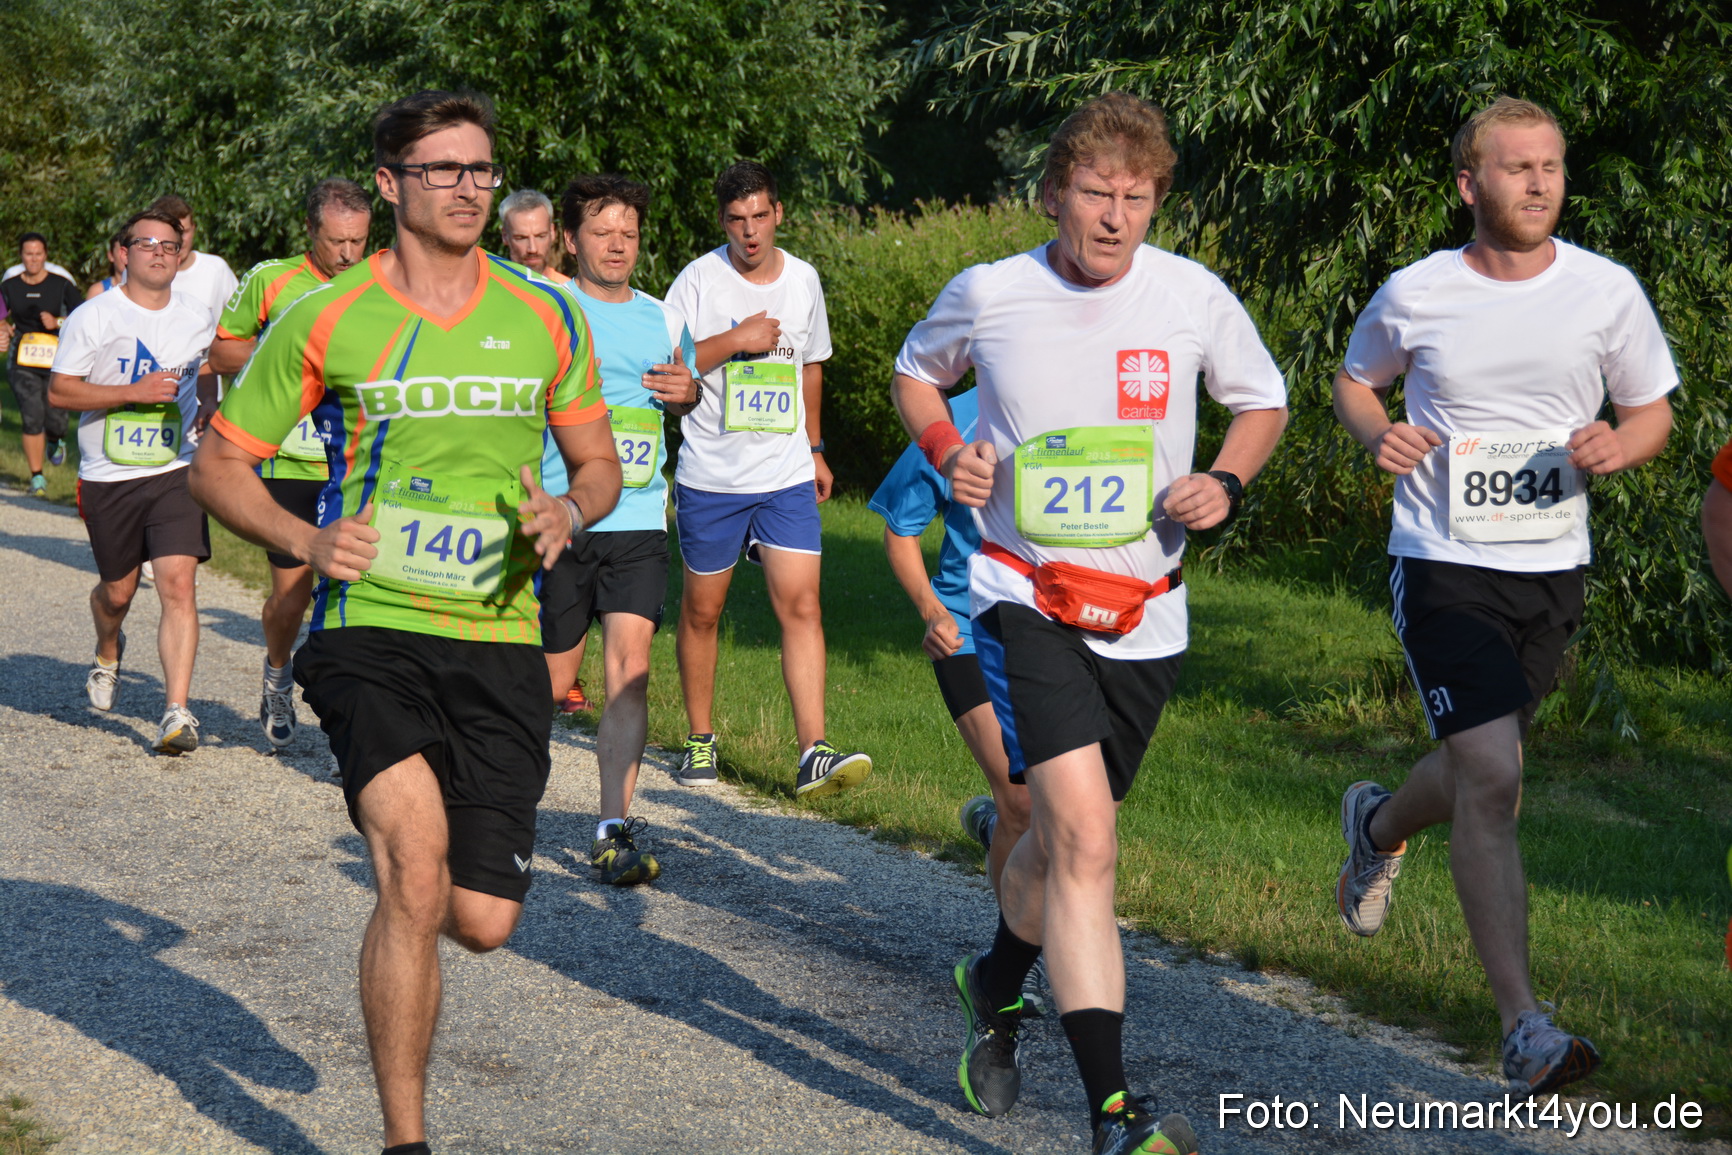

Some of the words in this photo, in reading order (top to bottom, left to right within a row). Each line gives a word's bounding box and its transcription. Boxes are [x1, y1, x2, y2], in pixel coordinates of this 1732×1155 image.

[23, 346, 54, 358] 1235
[354, 376, 543, 421] BOCK
[735, 390, 790, 413] 1470
[1121, 404, 1163, 418] caritas
[114, 425, 174, 447] 1479
[1037, 447, 1085, 457] firmenlauf
[1086, 452, 1111, 460] 2015
[1455, 438, 1557, 457] df-sports
[399, 487, 450, 504] firmenlauf
[1043, 475, 1125, 514] 212
[1463, 467, 1563, 507] 8934
[1083, 522, 1109, 530] Bestle
[1455, 510, 1571, 523] www.df-sports.de
[400, 520, 483, 565] 140
[402, 565, 444, 579] Christoph
[445, 572, 466, 581] März
[1081, 605, 1117, 625] LTU
[1429, 686, 1453, 717] 31
